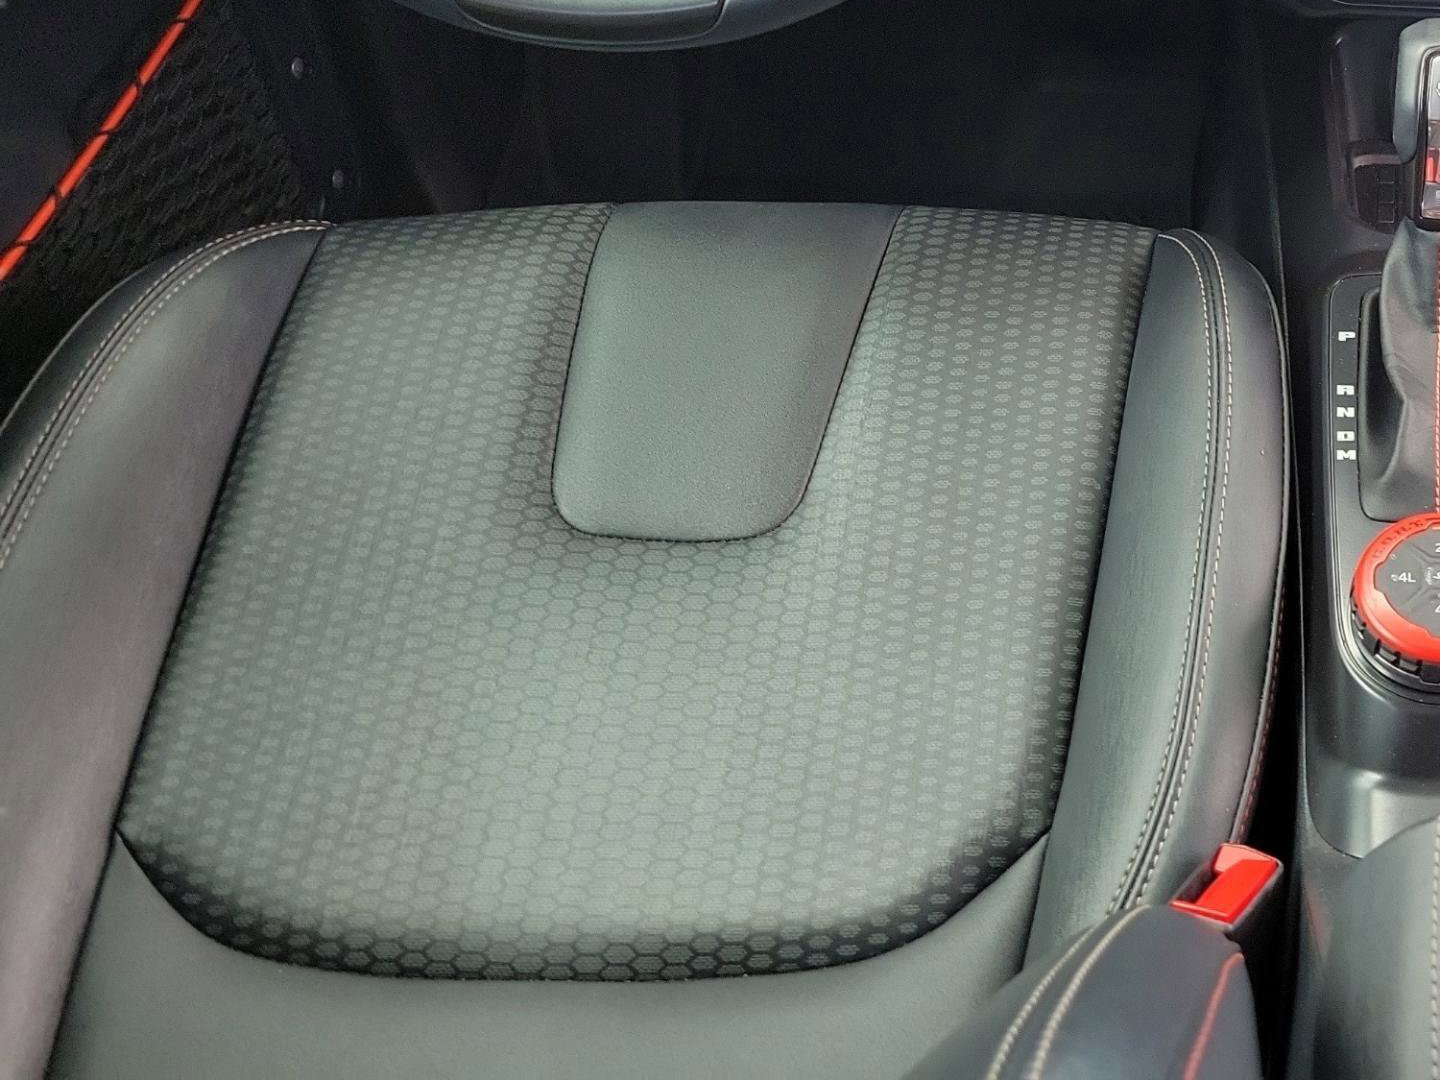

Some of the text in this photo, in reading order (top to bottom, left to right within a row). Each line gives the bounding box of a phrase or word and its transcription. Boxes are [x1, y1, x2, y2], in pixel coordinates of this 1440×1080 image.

[1337, 331, 1356, 343] P
[1336, 384, 1355, 396] R
[1336, 406, 1356, 418] N
[1336, 430, 1356, 442] D
[1336, 448, 1357, 461] M
[1398, 572, 1416, 583] 4L
